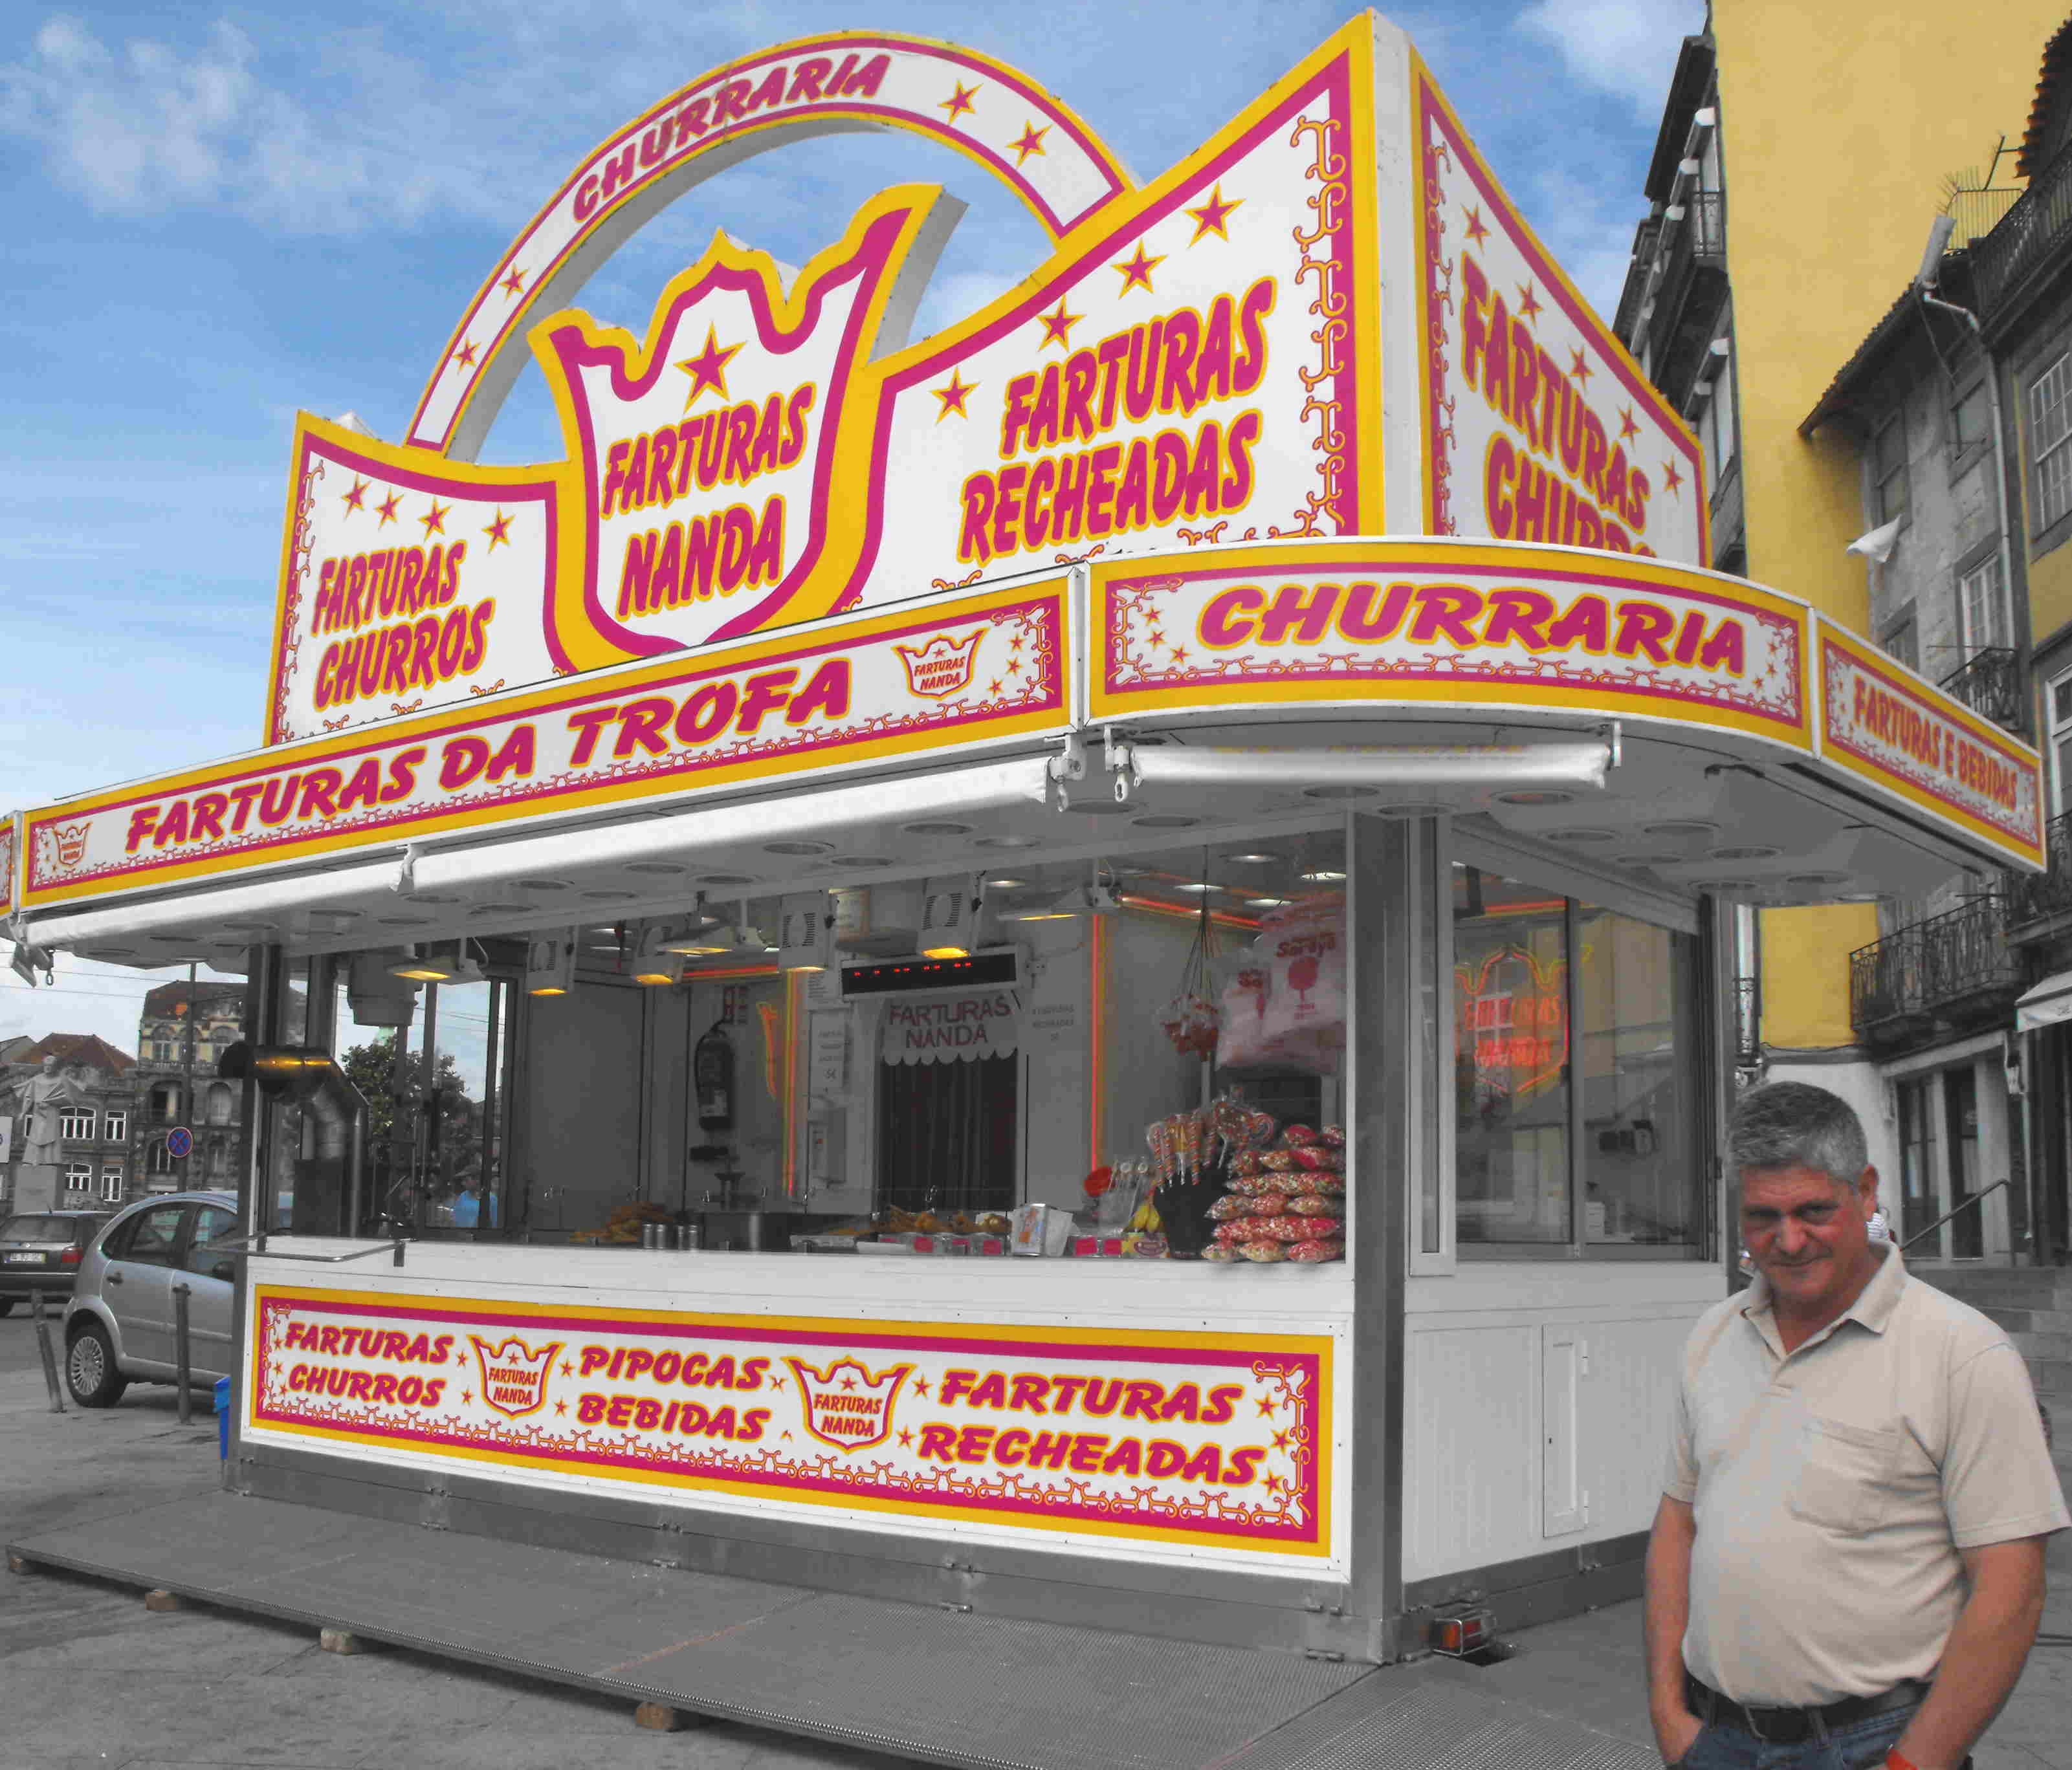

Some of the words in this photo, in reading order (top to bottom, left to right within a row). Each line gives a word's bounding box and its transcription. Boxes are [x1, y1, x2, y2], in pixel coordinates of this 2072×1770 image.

[573, 53, 892, 223] CHURRARIA
[1001, 278, 1276, 457] FARTURAS
[1462, 252, 1651, 532] FARTURAS
[601, 384, 815, 517] FARTURAS
[958, 411, 1261, 564] RECHEADAS
[616, 496, 784, 618] NANDA
[311, 541, 467, 634] FARTURAS
[314, 598, 494, 710] CHURROS
[1198, 582, 1747, 676] CHURRARIA
[914, 656, 965, 677] FARTURAS
[920, 672, 961, 690] NANDA
[124, 747, 428, 853] FARTURAS
[437, 723, 536, 791] DA
[566, 658, 852, 767] TROFA
[1853, 674, 1941, 771] FARTURAS
[1945, 728, 1954, 778] E
[1957, 736, 2017, 813] BEBIDAS
[889, 994, 1014, 1027] FARTURAS
[905, 1023, 989, 1049] NANDA
[283, 1321, 457, 1365] FARTURAS
[579, 1345, 771, 1391] PIPOCAS
[287, 1362, 448, 1408] CHURROS
[489, 1366, 539, 1386] FARTURAS
[493, 1386, 533, 1406] NANDA
[813, 1393, 883, 1414] FARTURAS
[939, 1369, 1245, 1425] FARTURAS
[577, 1392, 772, 1442] BEBIDAS
[821, 1415, 876, 1437] NANDA
[917, 1423, 1267, 1487] RECHEADAS
